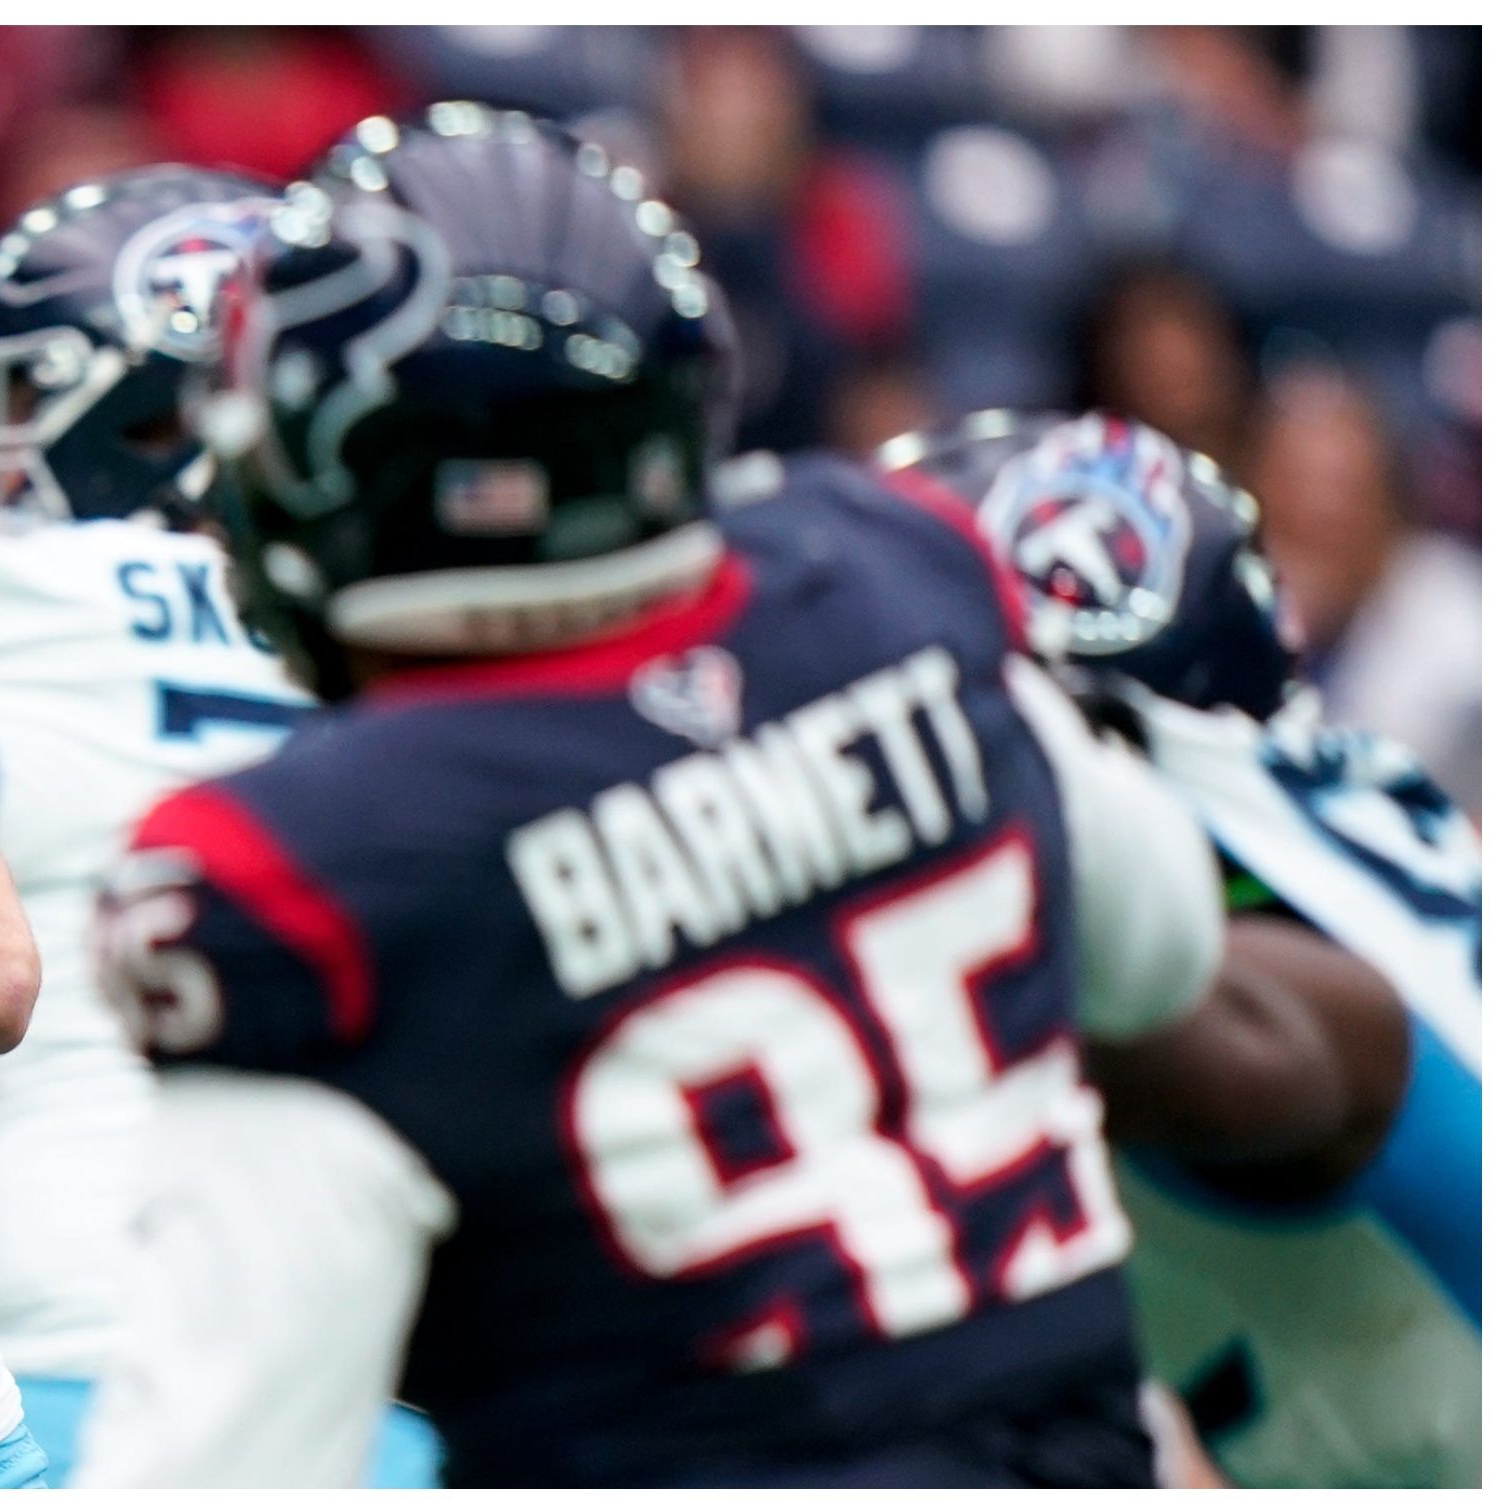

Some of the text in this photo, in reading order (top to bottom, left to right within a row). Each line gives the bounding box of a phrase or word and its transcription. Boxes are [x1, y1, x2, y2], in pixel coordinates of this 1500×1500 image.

[114, 561, 285, 656] SK
[1017, 498, 1124, 606] T
[504, 645, 991, 1000] BARNETT
[558, 818, 1134, 1366] 95
